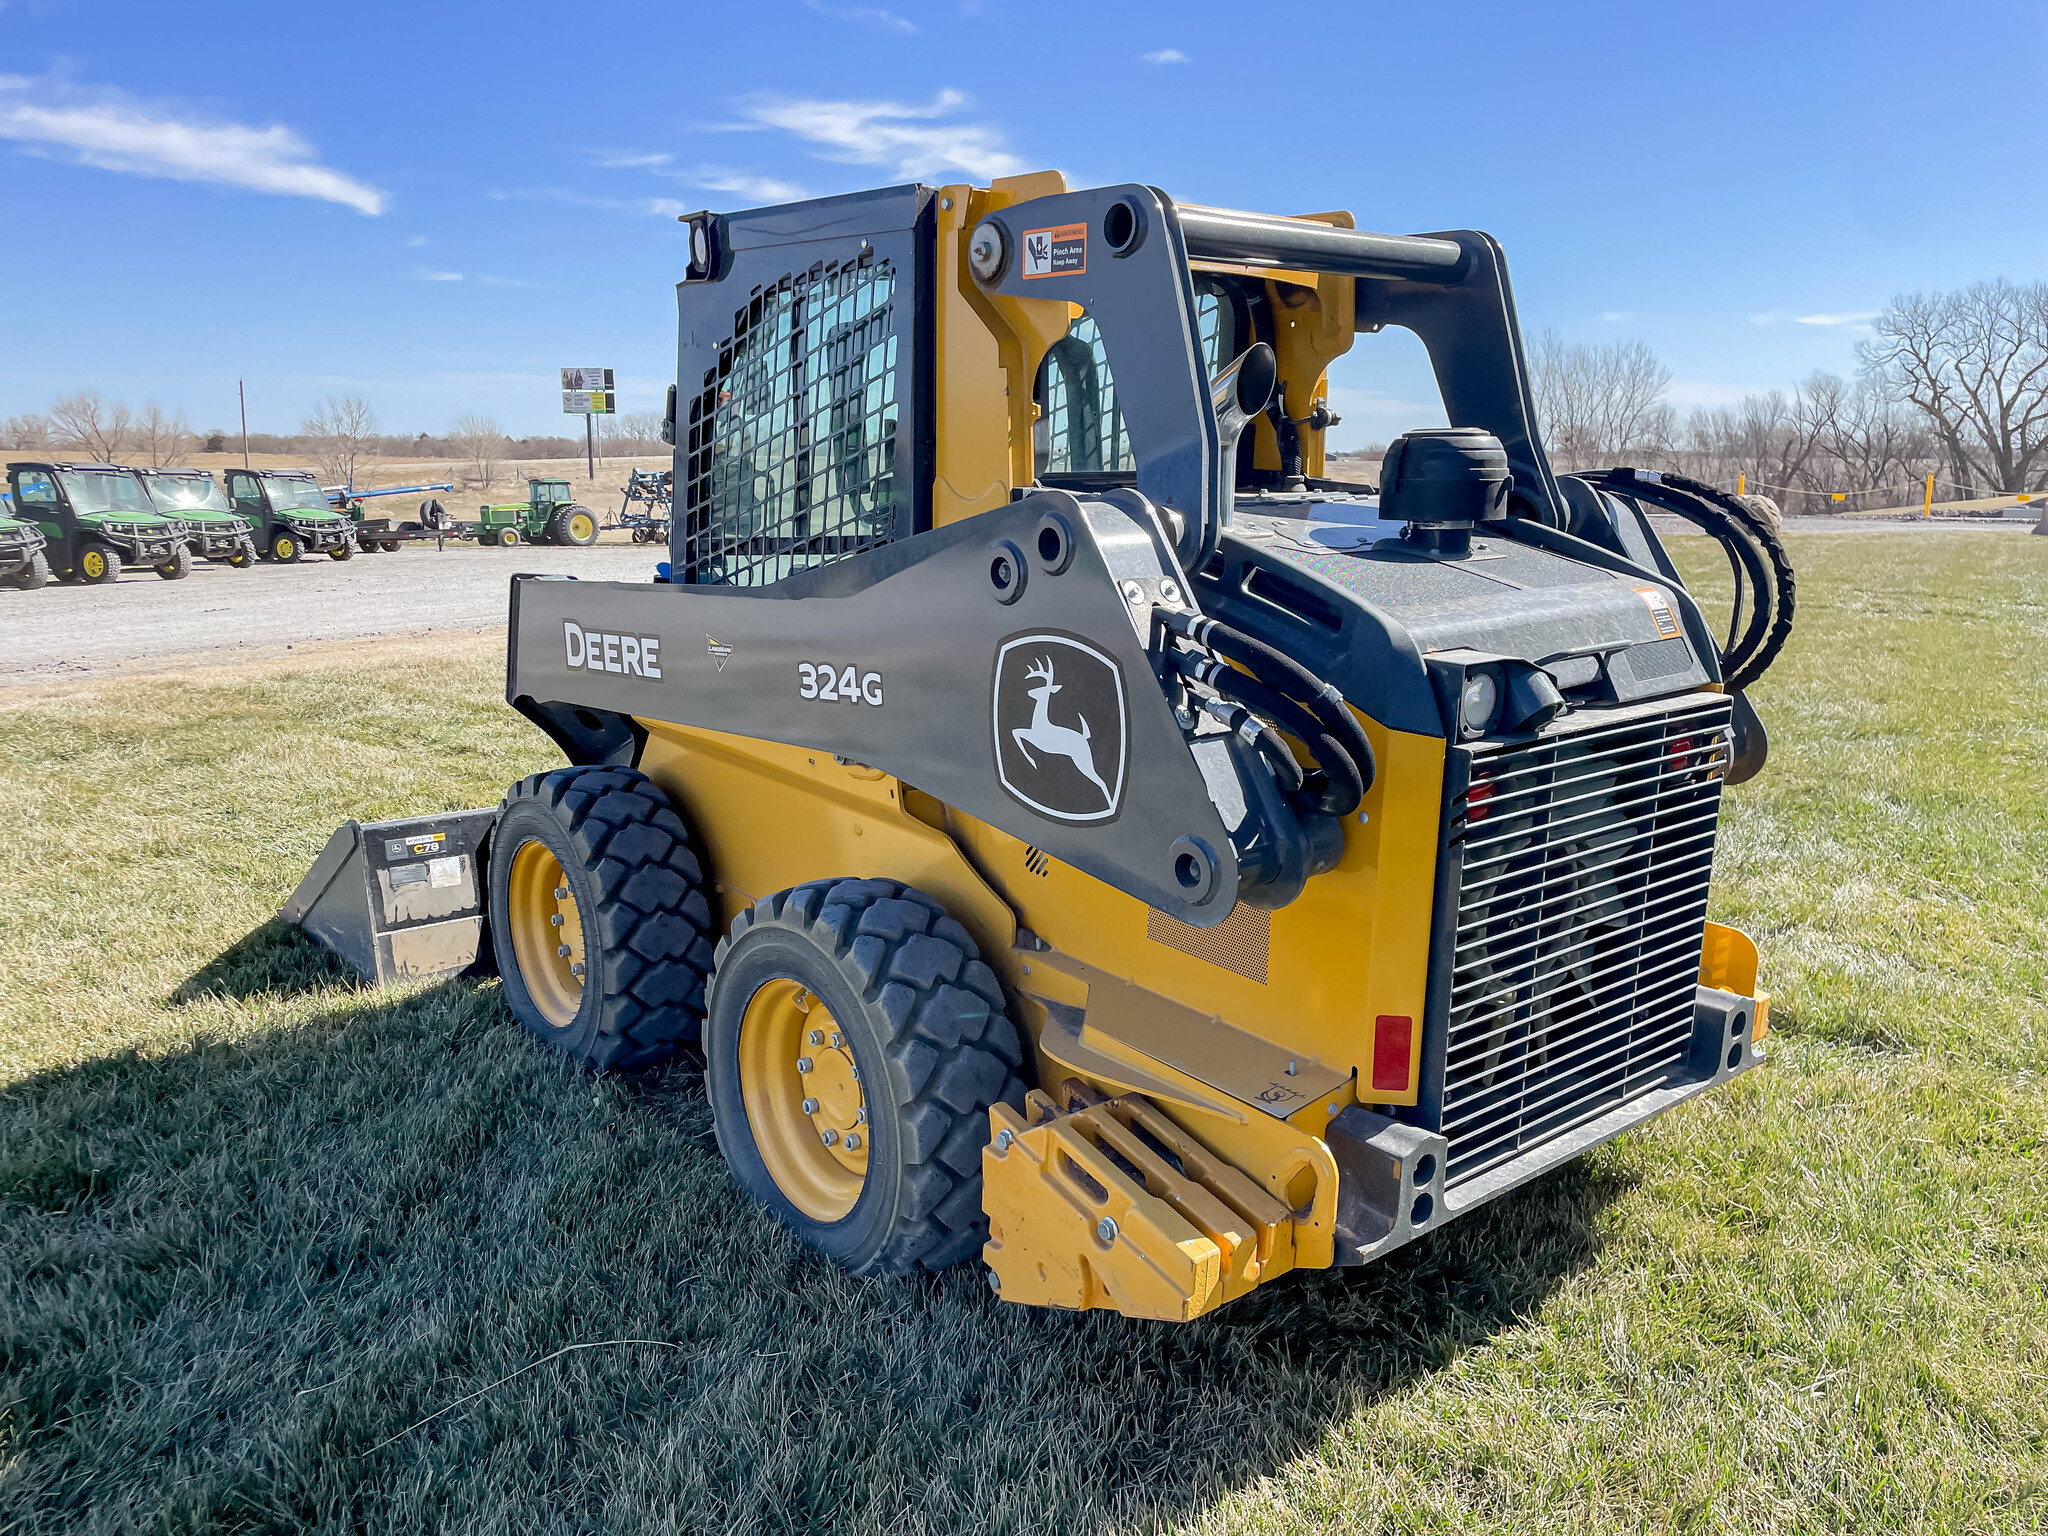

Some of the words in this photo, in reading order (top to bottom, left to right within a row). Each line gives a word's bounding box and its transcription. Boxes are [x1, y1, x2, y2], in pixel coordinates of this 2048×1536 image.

[1060, 228, 1084, 237] WARNING
[1053, 247, 1068, 256] Pinch
[1069, 246, 1083, 254] Area
[1053, 259, 1065, 267] Keep
[1066, 257, 1078, 265] Away
[563, 621, 662, 679] DEERE
[799, 662, 884, 706] 324G
[413, 842, 439, 853] C78
